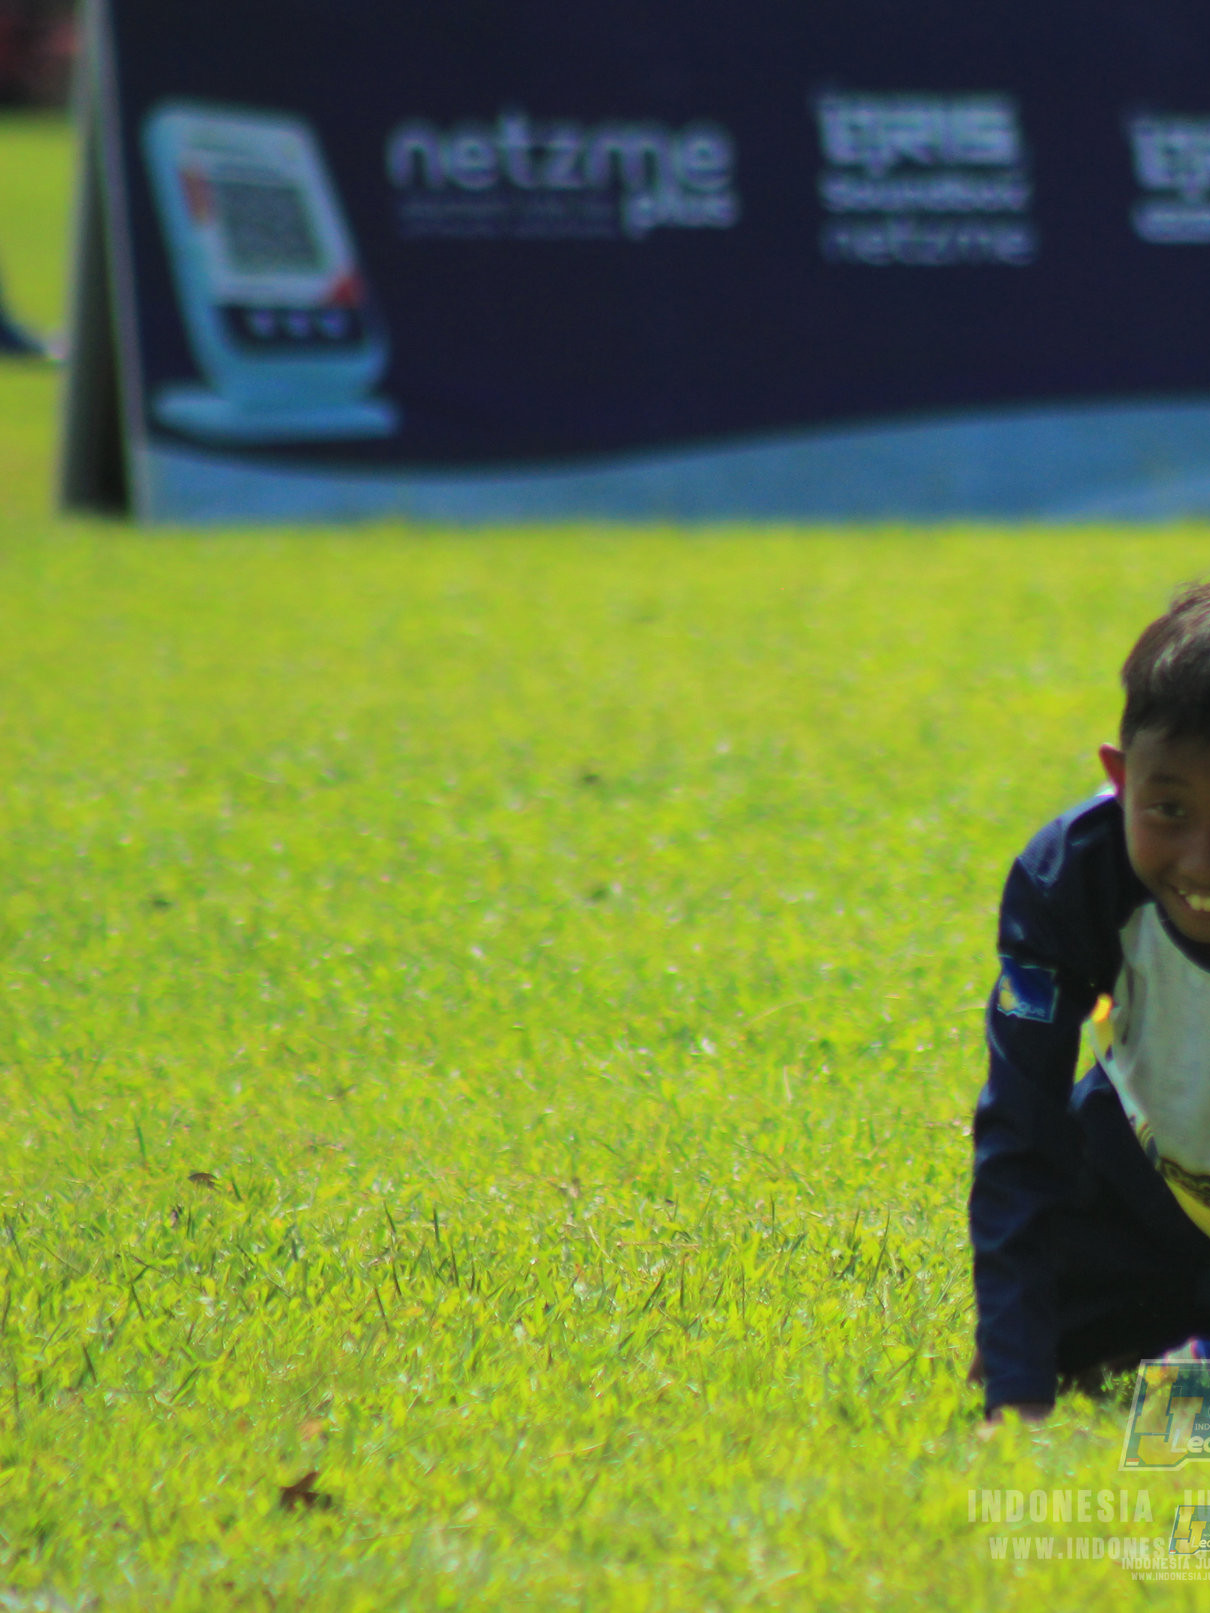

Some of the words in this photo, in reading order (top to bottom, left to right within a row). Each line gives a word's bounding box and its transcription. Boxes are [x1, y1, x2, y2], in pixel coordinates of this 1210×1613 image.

[387, 112, 735, 192] netzme
[623, 188, 741, 239] plus
[822, 216, 1034, 266] netzme
